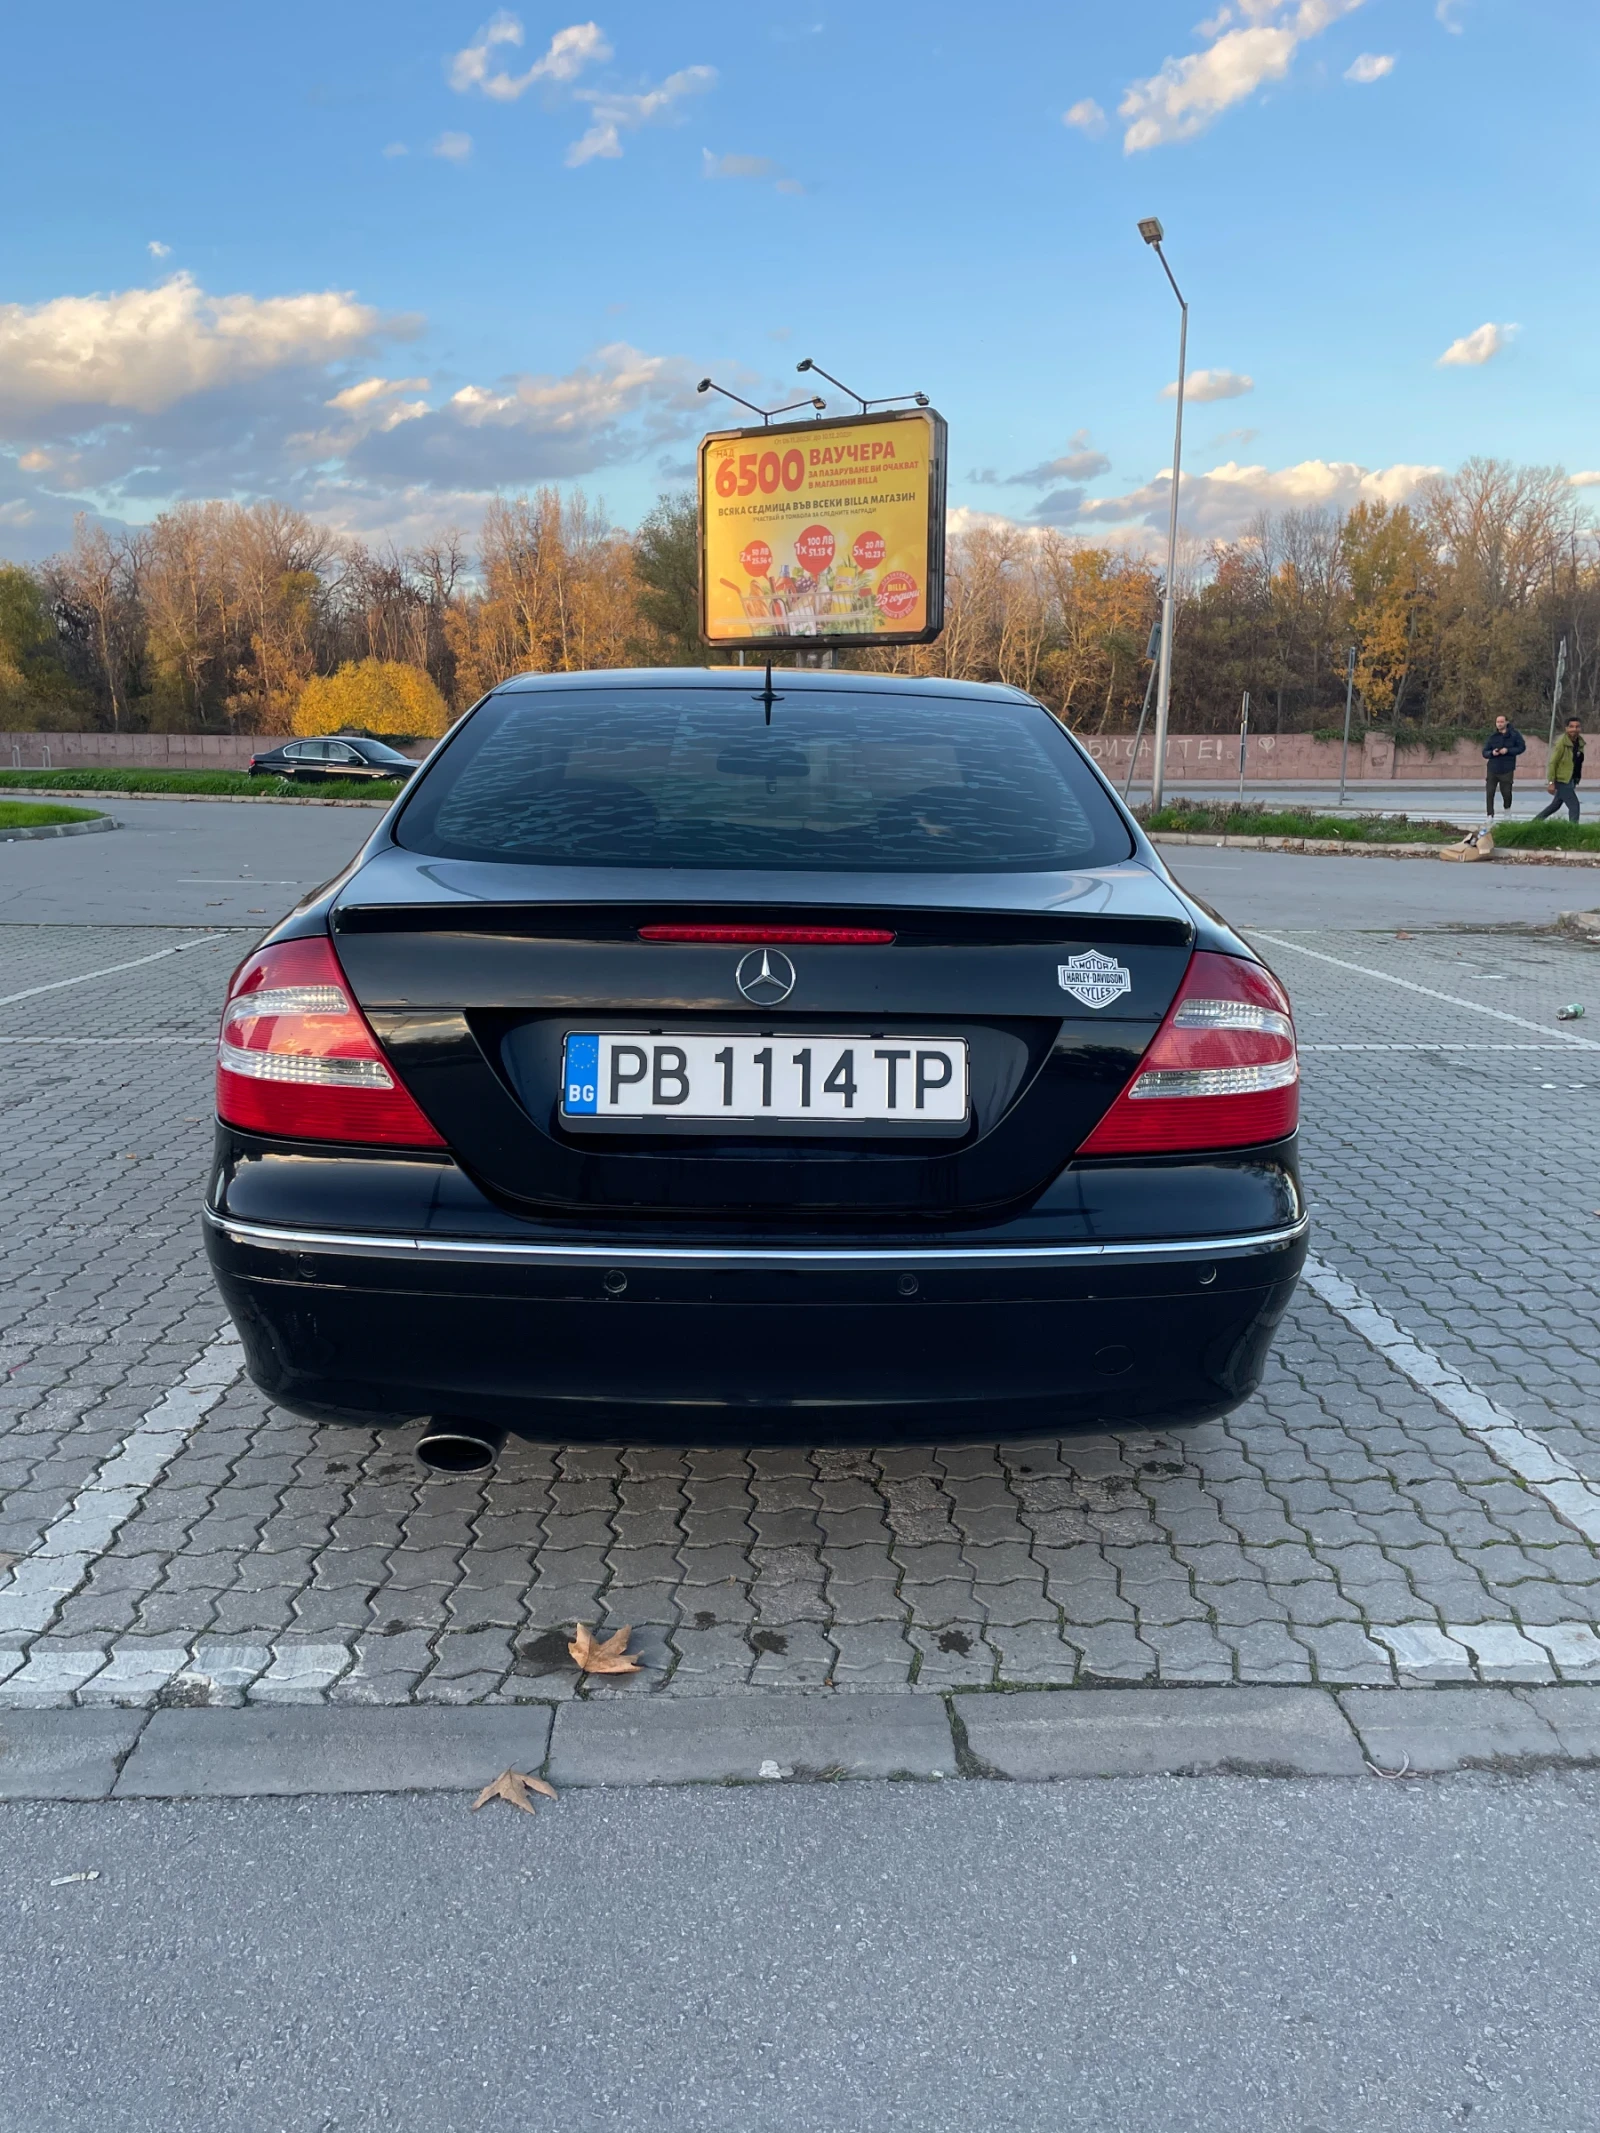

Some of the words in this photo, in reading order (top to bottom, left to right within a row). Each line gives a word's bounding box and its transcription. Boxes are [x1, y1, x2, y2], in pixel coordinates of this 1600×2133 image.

[716, 449, 734, 458] НАД
[810, 441, 896, 466] ВАУЧЕРА
[715, 449, 805, 498] 6500
[819, 466, 869, 477] ПАЗАРУВАНЕ
[871, 464, 881, 473] ВИ
[883, 461, 919, 471] ОЧАКВАТ
[808, 481, 813, 489] В
[815, 478, 856, 488] МАГАЗИНИ
[858, 476, 878, 485] BILLA
[718, 506, 746, 516] ВСЯКА
[748, 503, 791, 514] СЕДМИЦА
[793, 501, 811, 510] ВЪВ
[813, 498, 842, 509] ВСЕКИ
[844, 496, 868, 506] BILLA
[870, 492, 915, 504] МАГАЗИН
[753, 513, 779, 522] УЧАСТВАЙ
[820, 509, 849, 517] СЛЕДНИТЕ
[807, 537, 820, 546] 100
[821, 535, 833, 545] ЛВ
[865, 541, 874, 549] 20
[875, 540, 885, 548] ЛВ
[795, 543, 807, 555] 1x
[808, 548, 825, 557] 51.13
[827, 547, 833, 556] €
[887, 583, 907, 591] BILLA
[874, 592, 889, 606] 25
[889, 590, 920, 605] години
[1079, 959, 1109, 970] MOTOR
[1067, 972, 1123, 984] HARLEY-DAVIDSON
[1080, 987, 1111, 1000] CYCLES
[610, 1045, 690, 1106] PB
[714, 1047, 857, 1108] 1114
[874, 1050, 952, 1109] TP
[568, 1084, 595, 1102] BG
